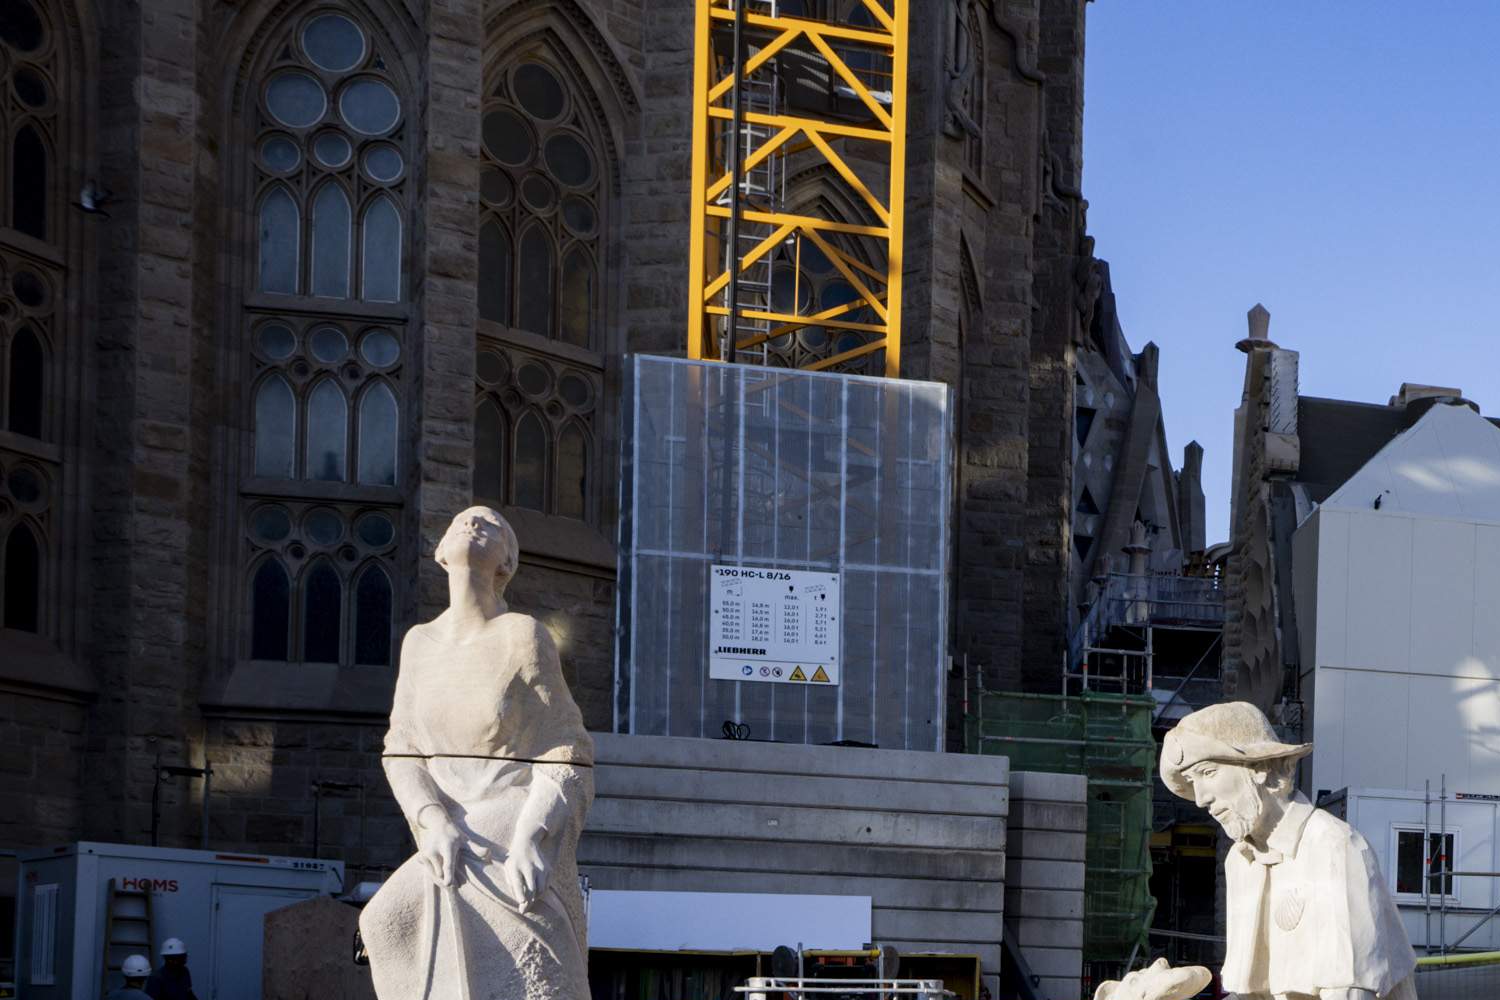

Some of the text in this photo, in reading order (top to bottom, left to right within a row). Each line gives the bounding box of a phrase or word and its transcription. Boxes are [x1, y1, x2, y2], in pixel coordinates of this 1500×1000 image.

[719, 568, 791, 581] 190 HC-L 8/16
[718, 646, 766, 655] LIEBHERR
